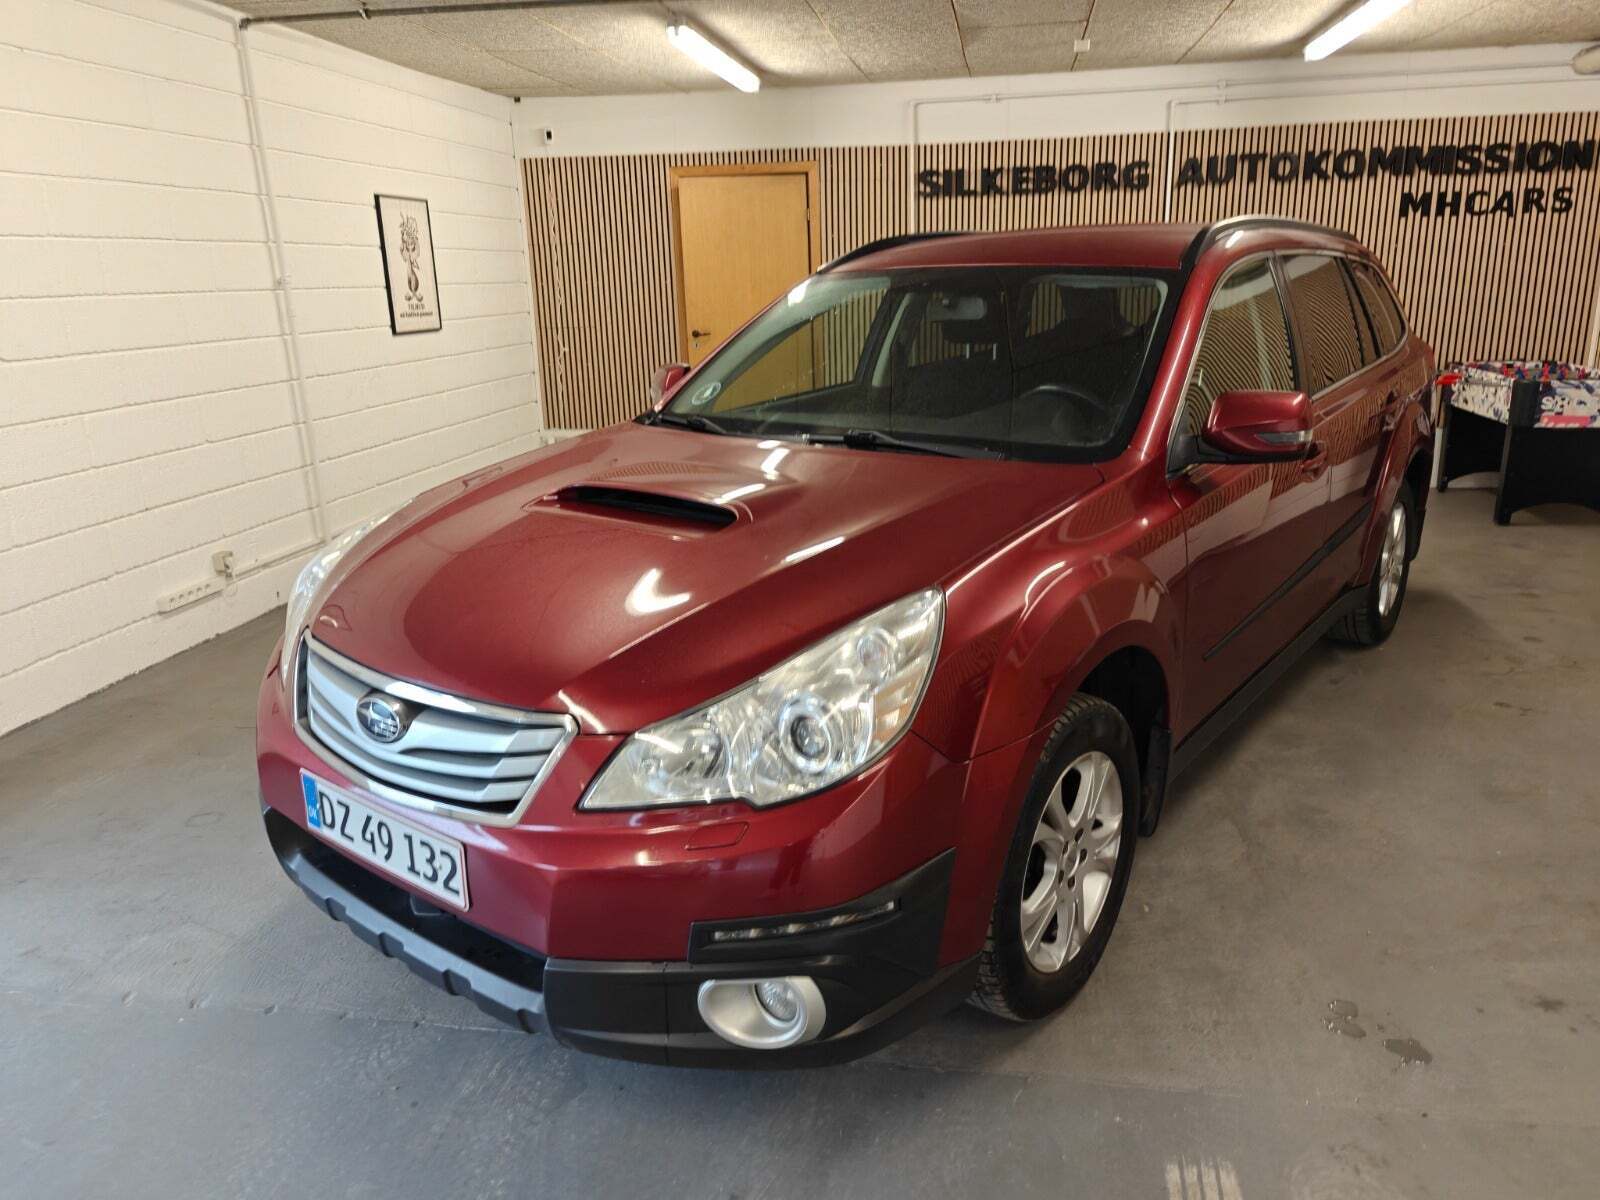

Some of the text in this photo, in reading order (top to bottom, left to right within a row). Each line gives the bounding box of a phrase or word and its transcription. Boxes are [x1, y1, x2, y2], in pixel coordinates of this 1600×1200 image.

[918, 139, 1596, 198] SILKEBORG AUTOKOMMISSION
[318, 791, 460, 895] DZ 49 132
